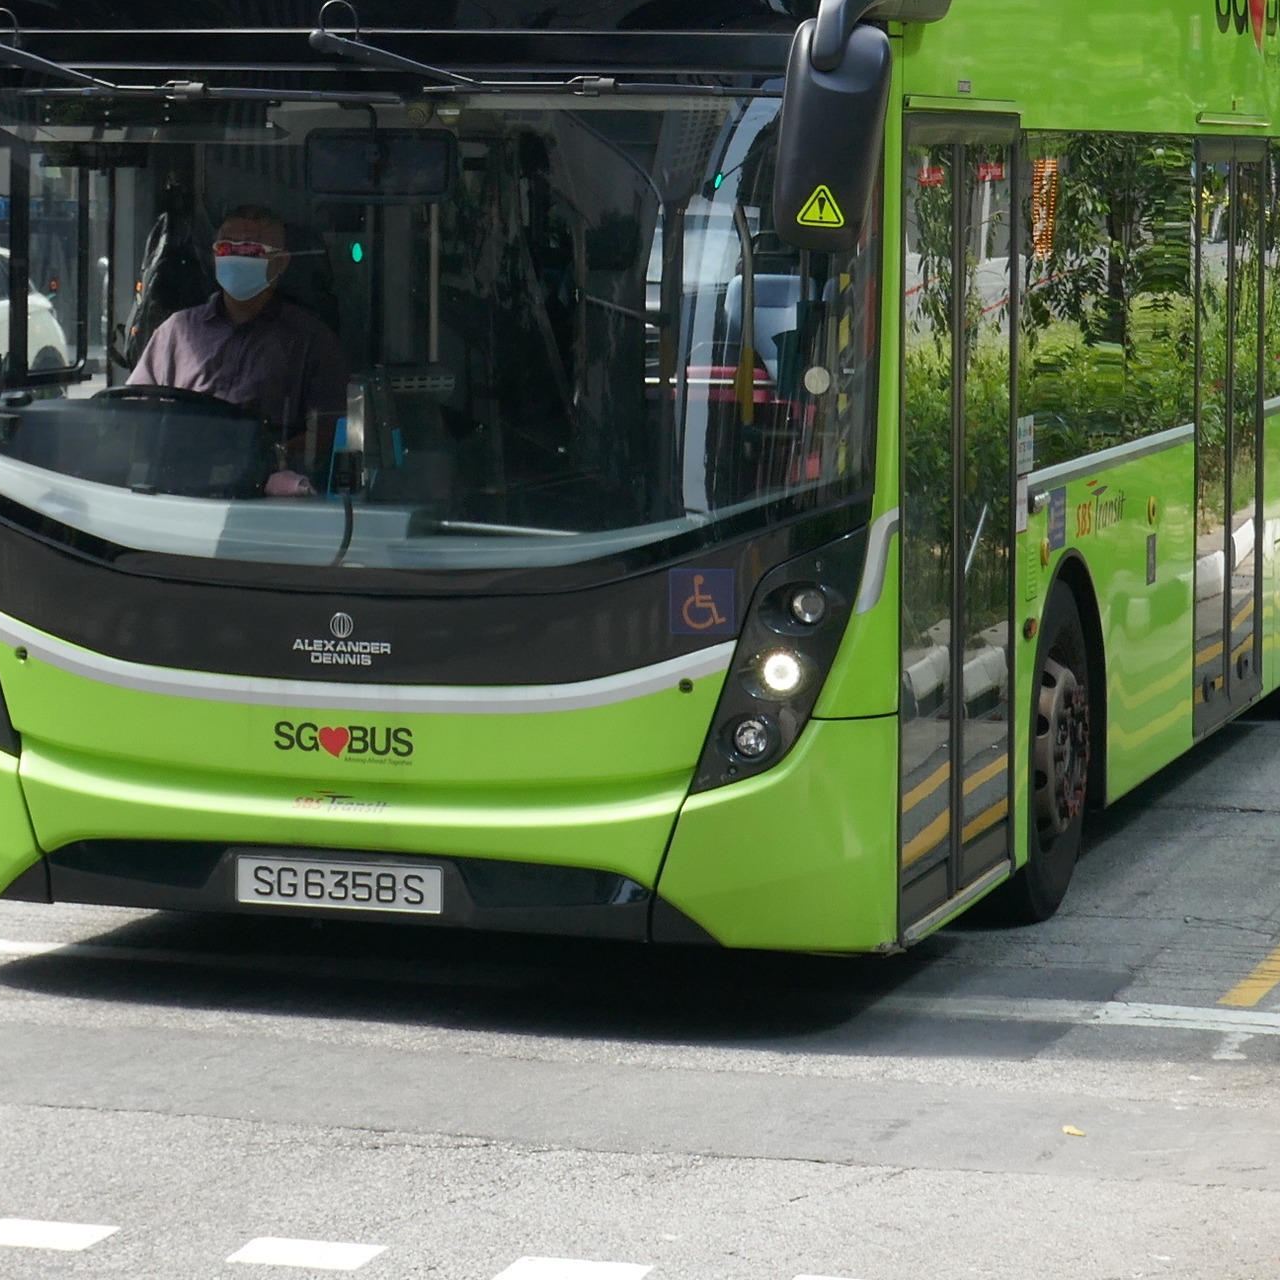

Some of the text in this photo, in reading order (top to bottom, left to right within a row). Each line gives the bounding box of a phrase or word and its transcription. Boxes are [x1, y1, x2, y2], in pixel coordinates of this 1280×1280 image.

[1076, 501, 1092, 539] SBS
[1092, 486, 1126, 539] Transit
[292, 638, 392, 655] ALEXANDER
[310, 651, 372, 666] DENNIS
[292, 794, 389, 813] SBS Transit
